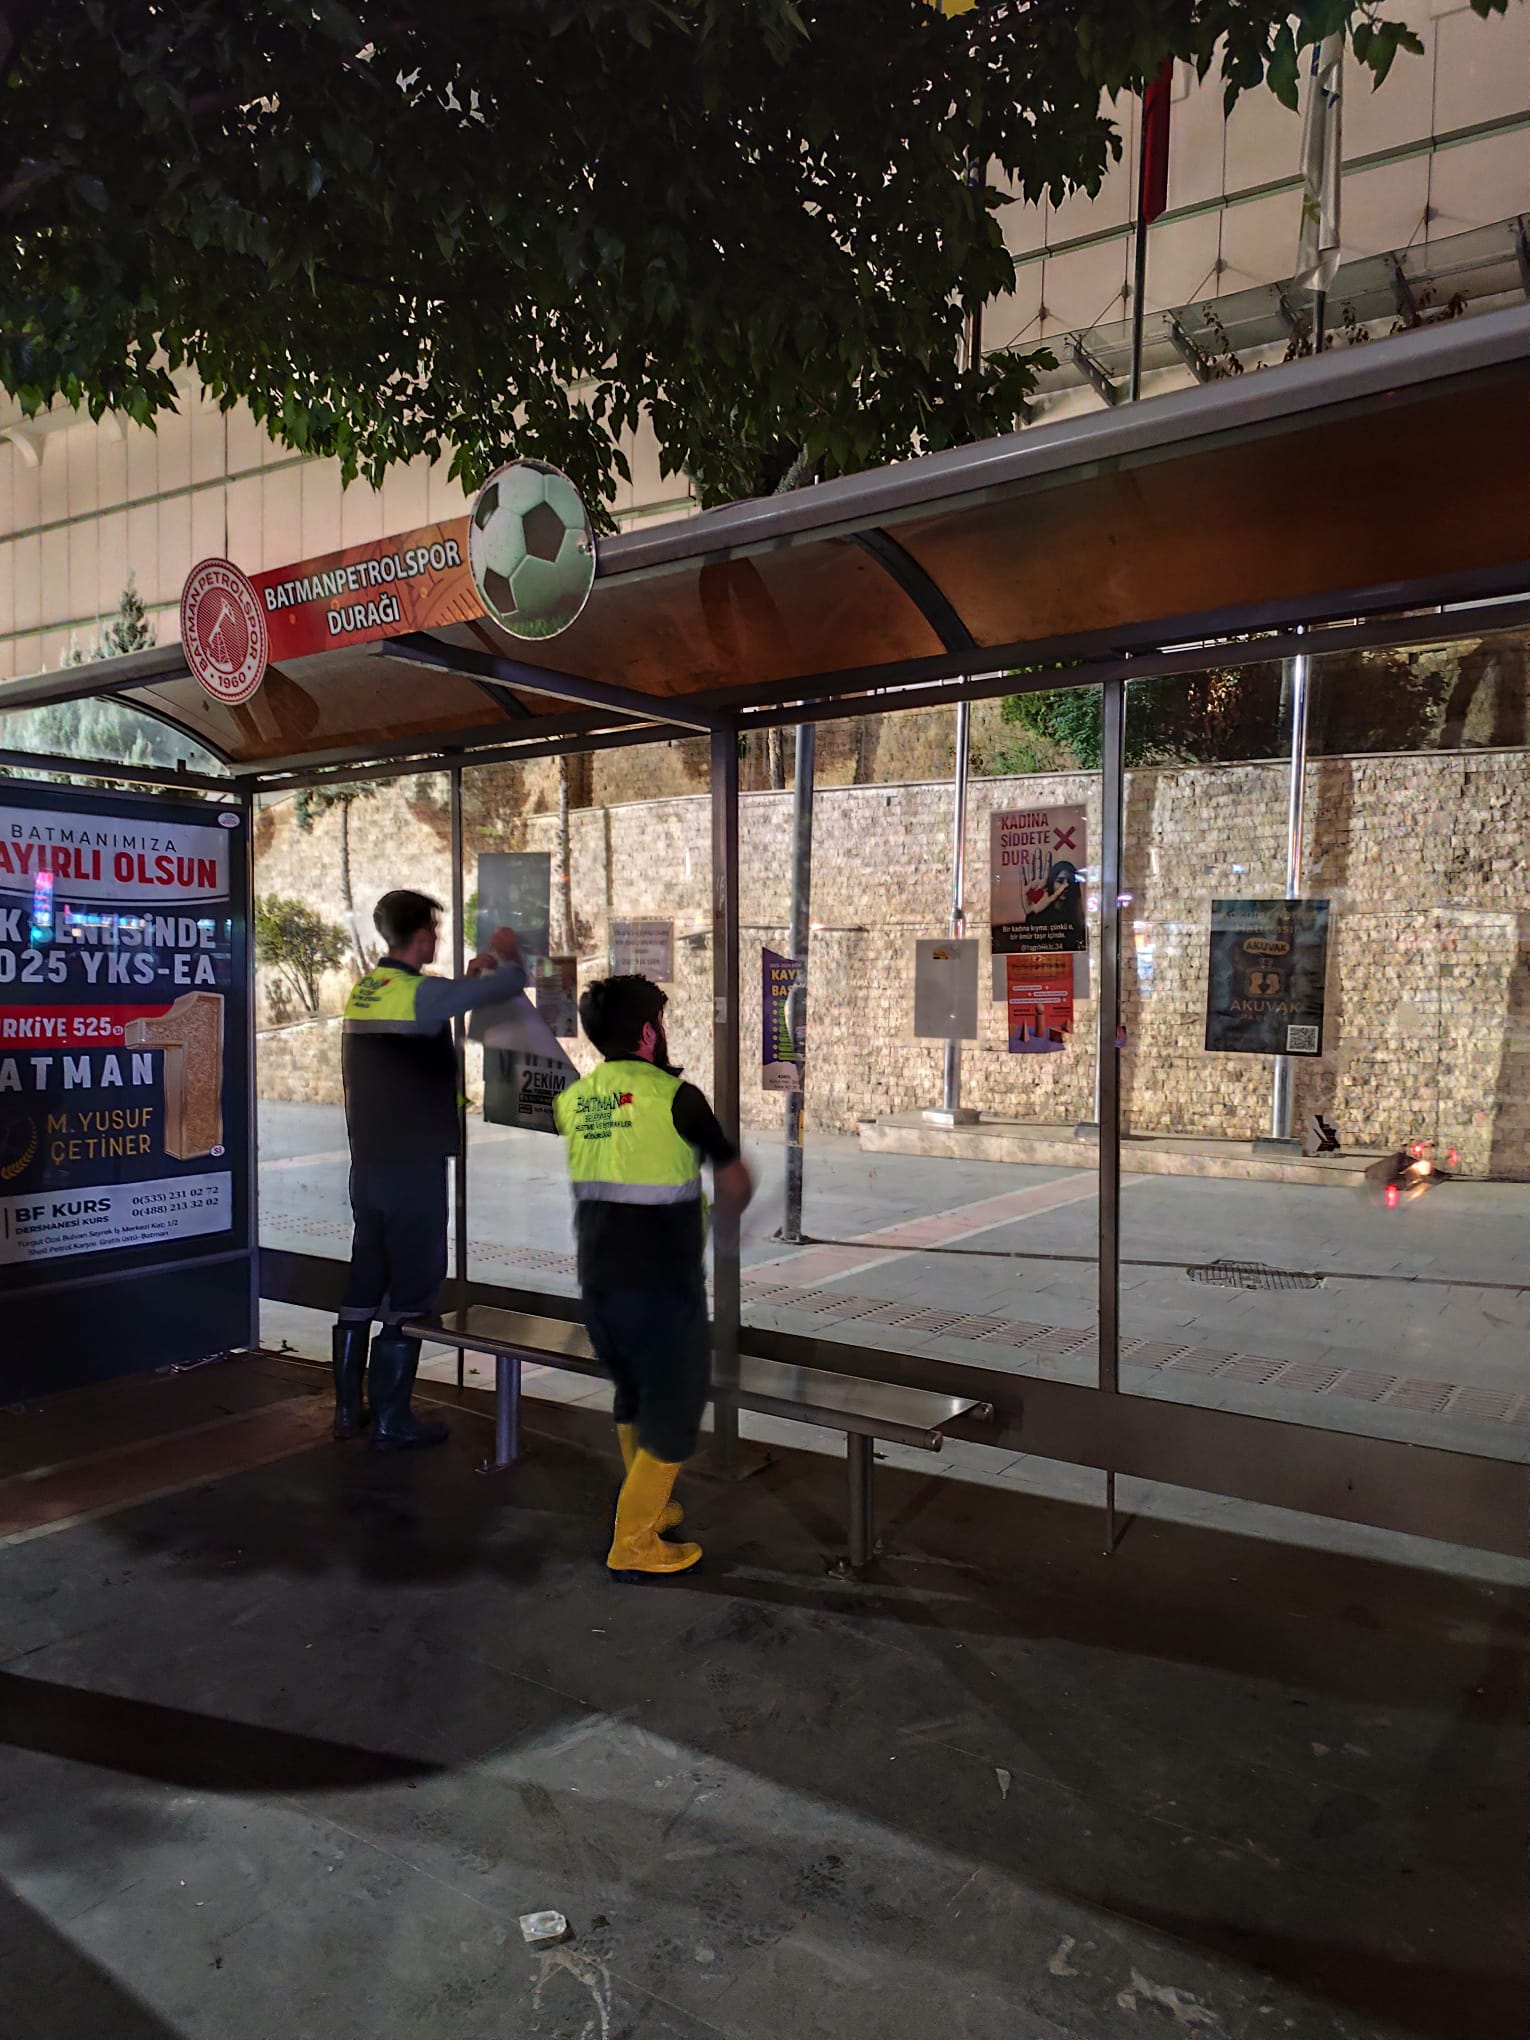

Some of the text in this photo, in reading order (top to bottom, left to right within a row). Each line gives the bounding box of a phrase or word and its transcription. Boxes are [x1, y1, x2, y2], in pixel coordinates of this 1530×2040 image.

[264, 539, 461, 612] BATMANPETROLSPOR
[188, 571, 258, 672] BATMAN PETROL SPOR
[327, 596, 400, 636] DURAĞI
[218, 672, 246, 689] 1960
[1001, 813, 1049, 830] KADINA
[11, 824, 177, 853] BATMANIMIZA
[114, 852, 217, 888] OLSUN
[1002, 849, 1030, 866] DUR
[1246, 942, 1287, 952] AKUVAK
[80, 950, 216, 984] YKS-EA
[73, 1017, 112, 1037] 525
[0, 1053, 153, 1092] ATMAN
[522, 1070, 566, 1093] 2 EKİM
[51, 1134, 152, 1165] ÇETİNER
[15, 1186, 219, 1223] BF KURS 0(535) 231 02 72
[132, 1197, 219, 1217] 0(488) 213 32 02
[82, 1215, 109, 1226] KURS
[166, 1218, 179, 1228] 1/2
